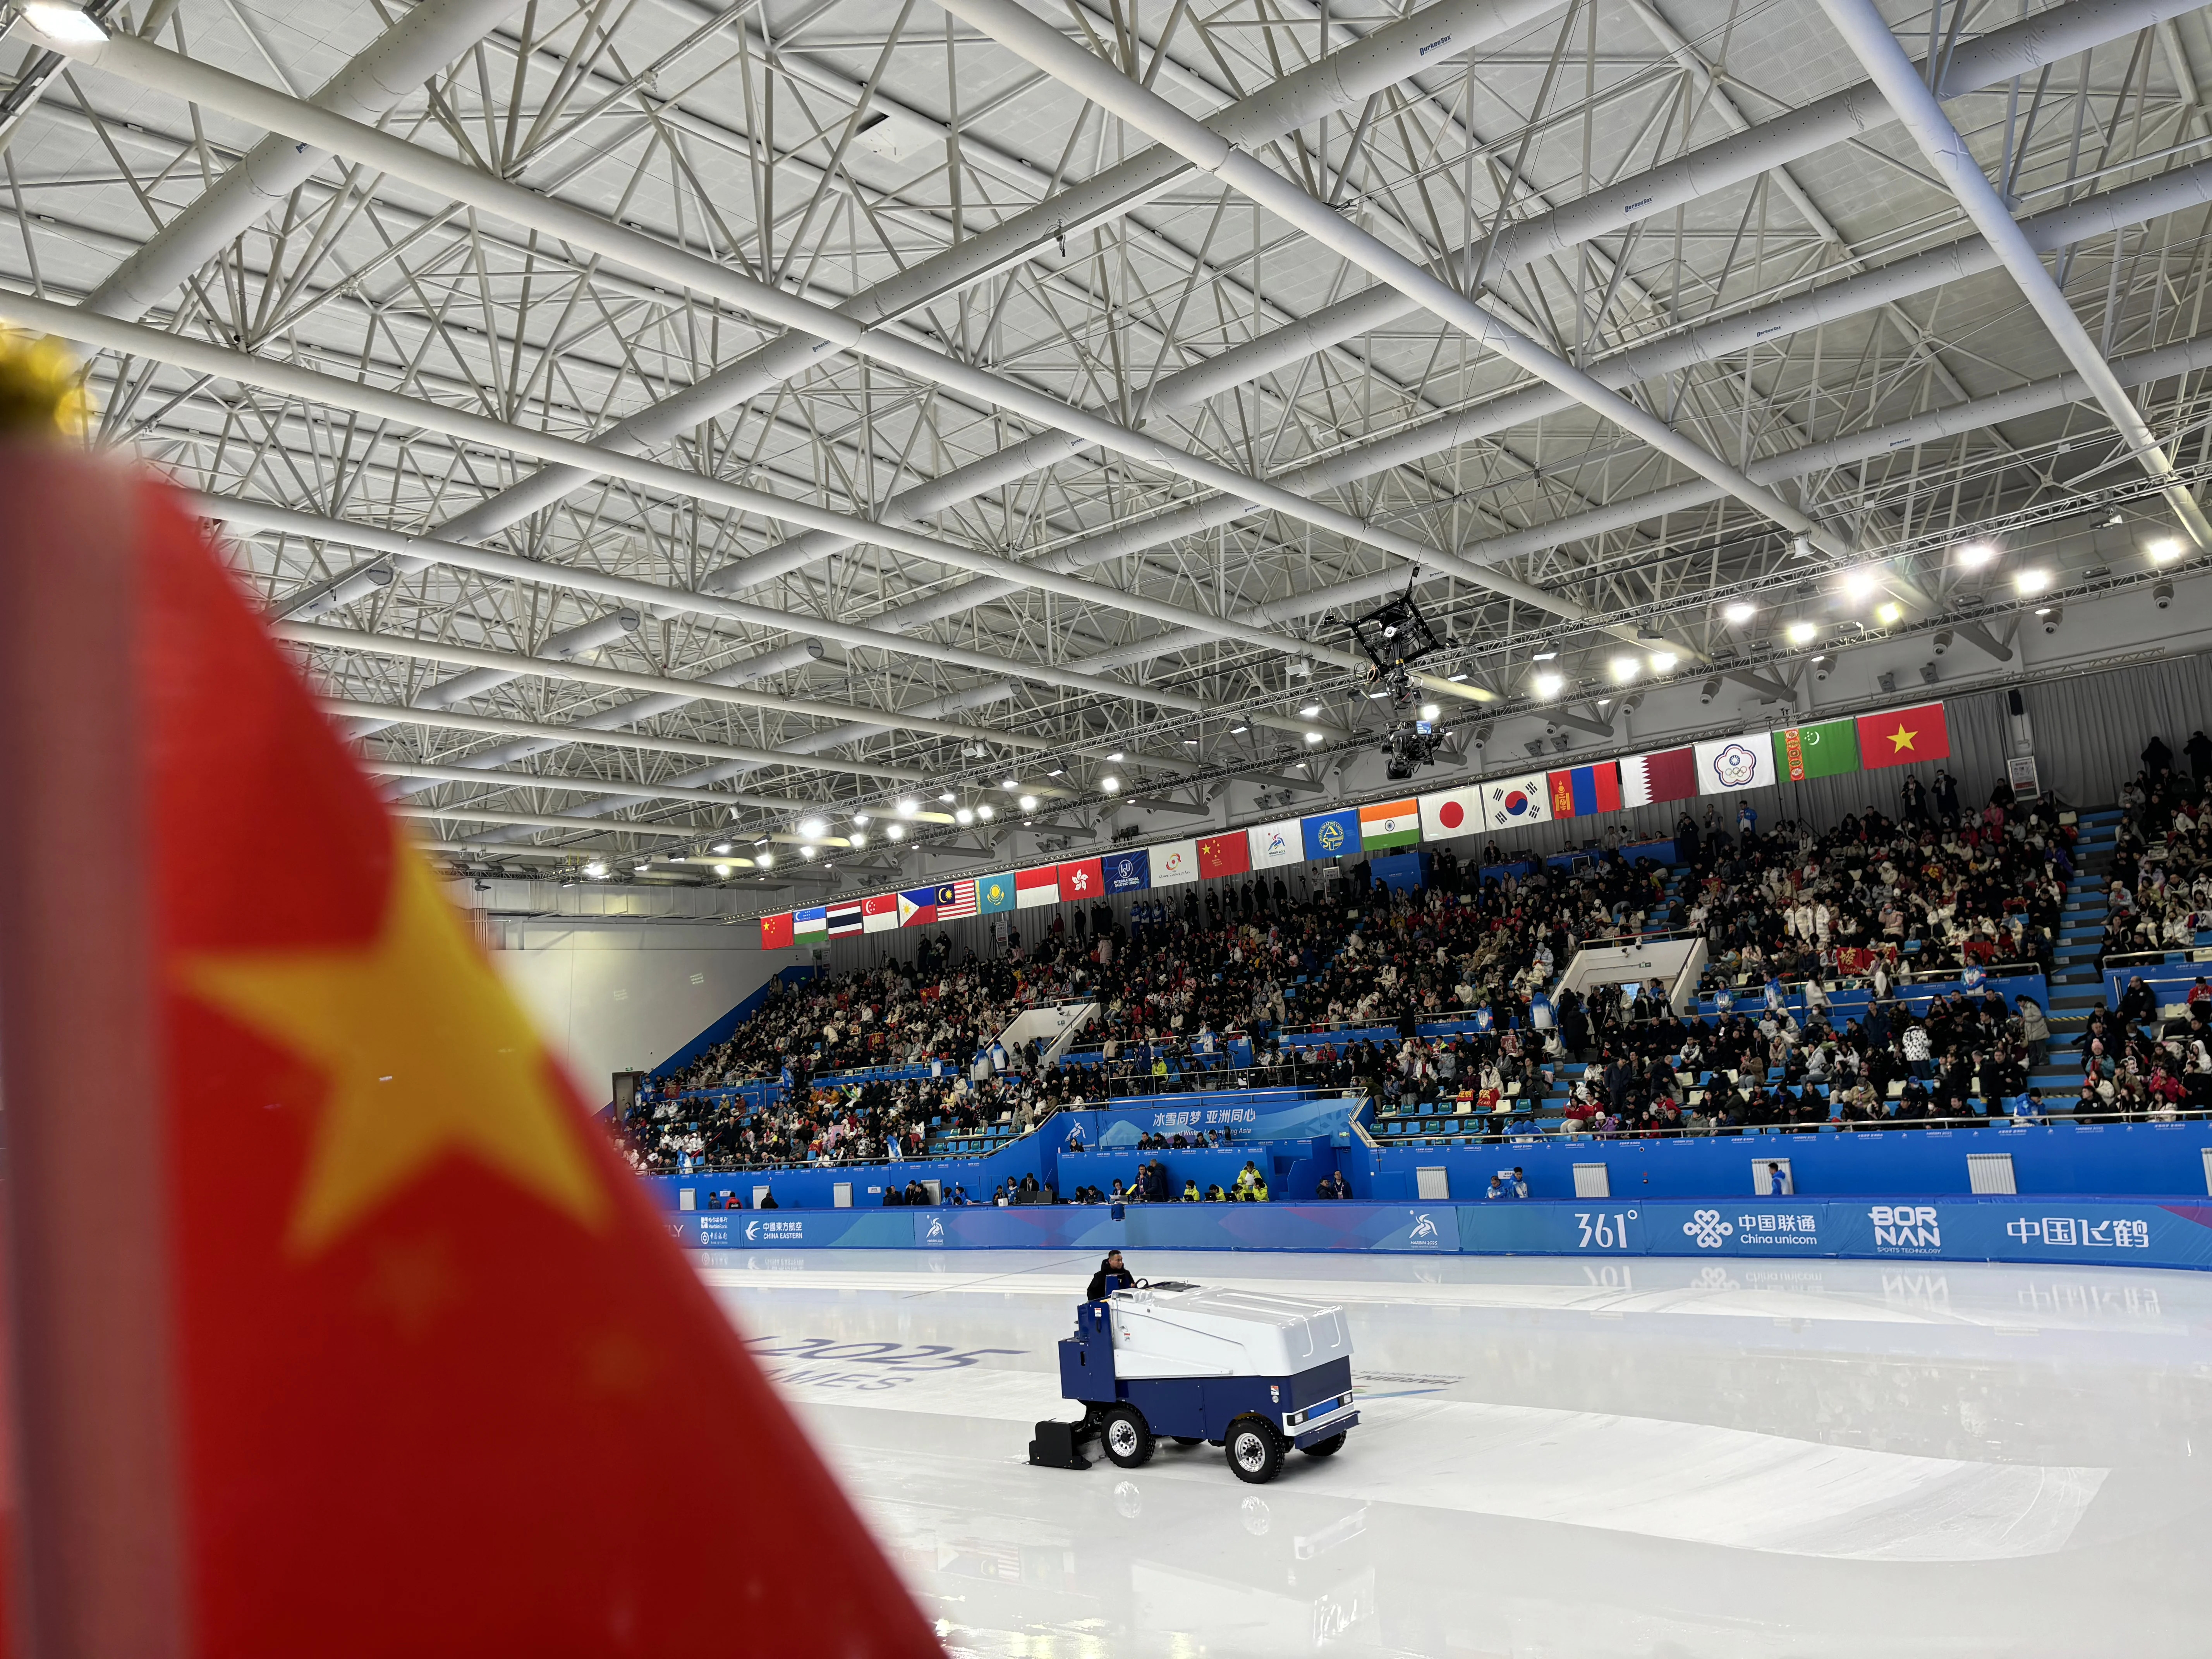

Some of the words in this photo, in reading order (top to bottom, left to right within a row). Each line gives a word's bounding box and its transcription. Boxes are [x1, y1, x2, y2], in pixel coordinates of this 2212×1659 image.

[1152, 1110, 1201, 1127] 冰雪同梦
[1205, 1108, 1255, 1124] 亚洲同心
[1239, 1127, 1251, 1135] Asia
[1738, 1214, 1816, 1232] 中国联通
[1867, 1206, 1938, 1226] BOR
[763, 1221, 802, 1231] 中國東方航空
[2006, 1218, 2149, 1248] 中国飞鹤
[1740, 1233, 1773, 1244] China
[1775, 1234, 1817, 1244] unicom
[1874, 1226, 1941, 1247] NAN
